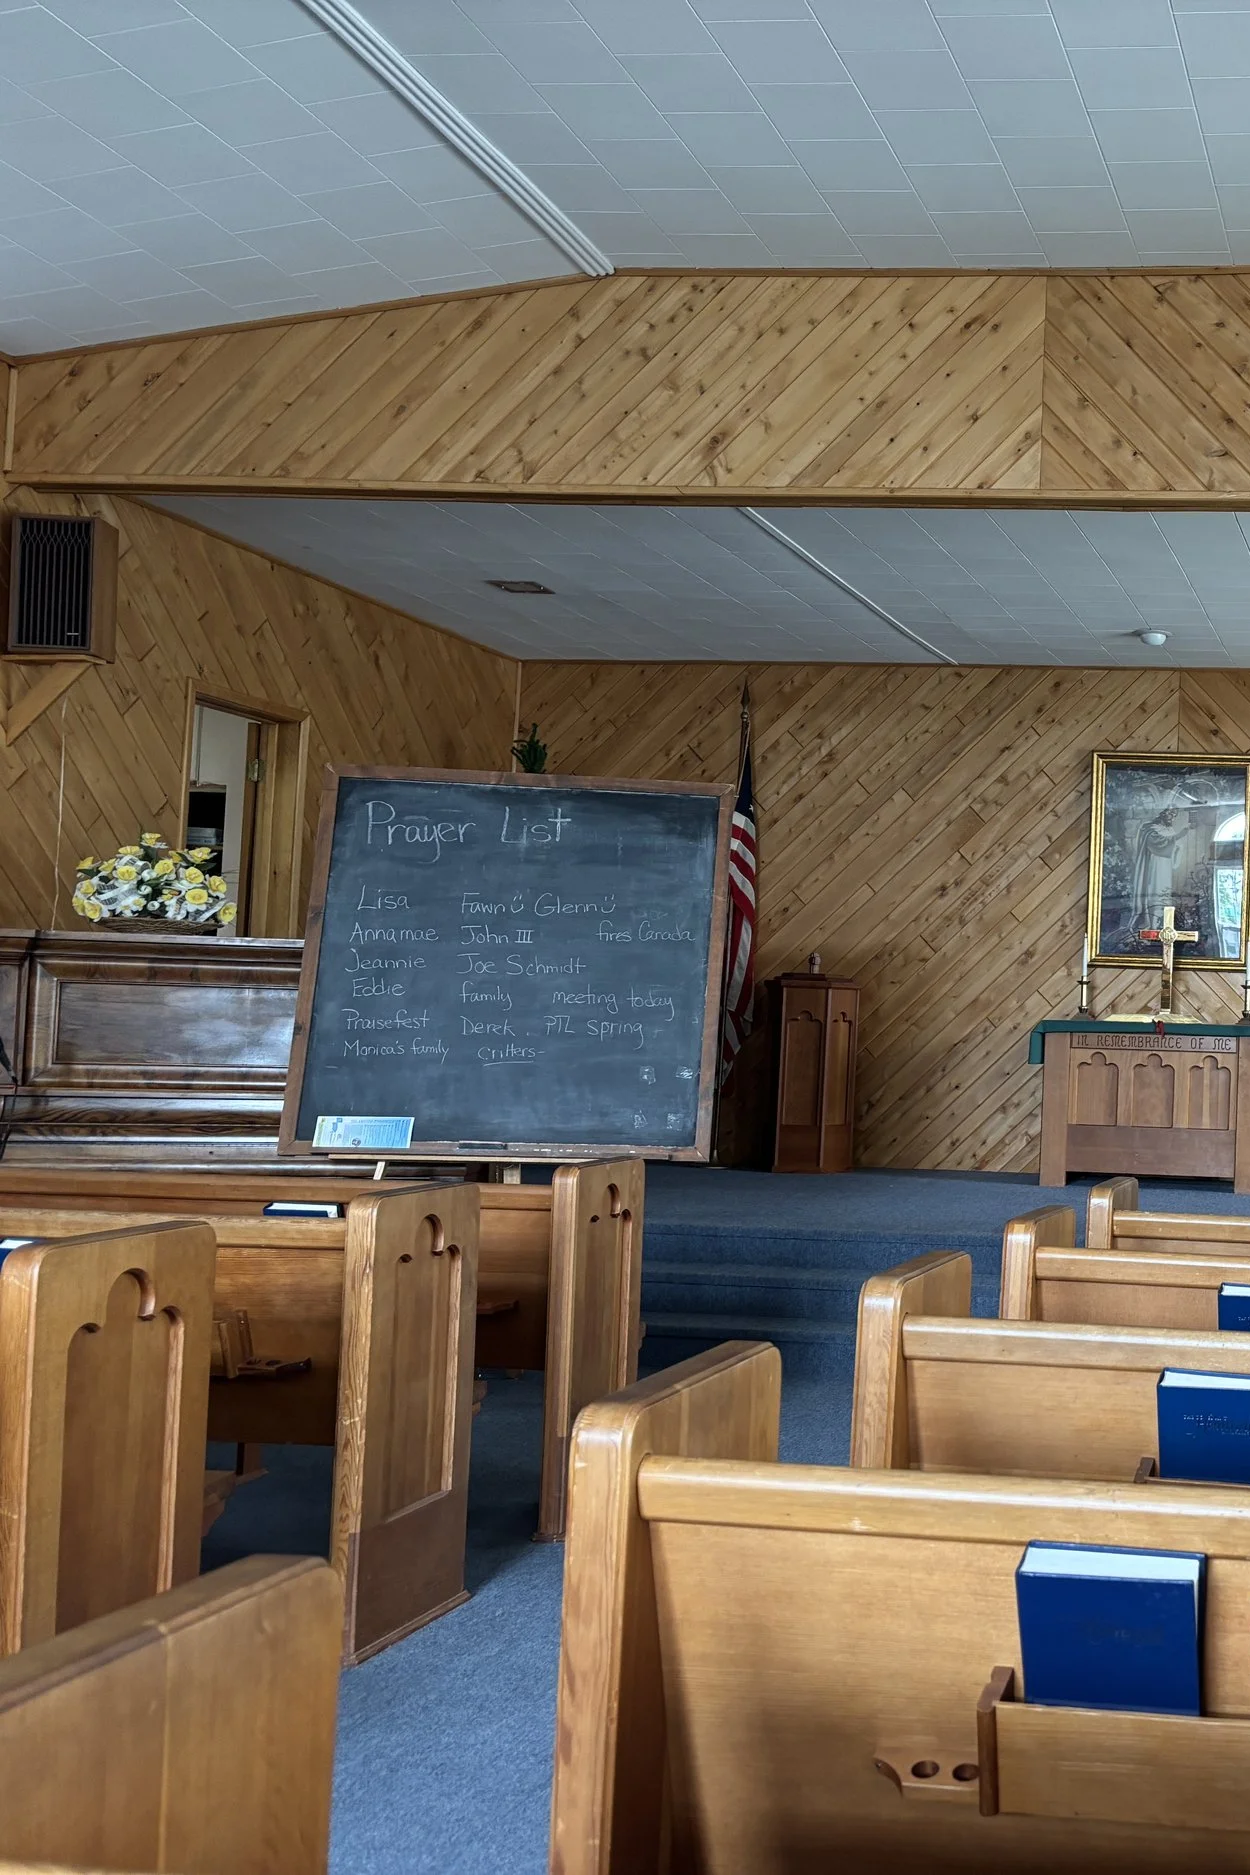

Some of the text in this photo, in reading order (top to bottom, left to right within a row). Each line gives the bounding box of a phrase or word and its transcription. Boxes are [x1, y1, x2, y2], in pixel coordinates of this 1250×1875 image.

[366, 800, 572, 865] Prayer List
[357, 884, 410, 911] Lisa
[461, 892, 598, 917] Fawn Glenn
[461, 924, 509, 945] John
[638, 920, 696, 942] Canada
[344, 948, 427, 973] Jeannie
[456, 952, 587, 976] Joe Schmidt
[352, 976, 406, 998] Eddie
[552, 983, 675, 1021] meeting today
[460, 1015, 516, 1037] Derek
[343, 1039, 405, 1057] Monica's
[1077, 1034, 1232, 1051] IN REMEMBRANCE OF ME
